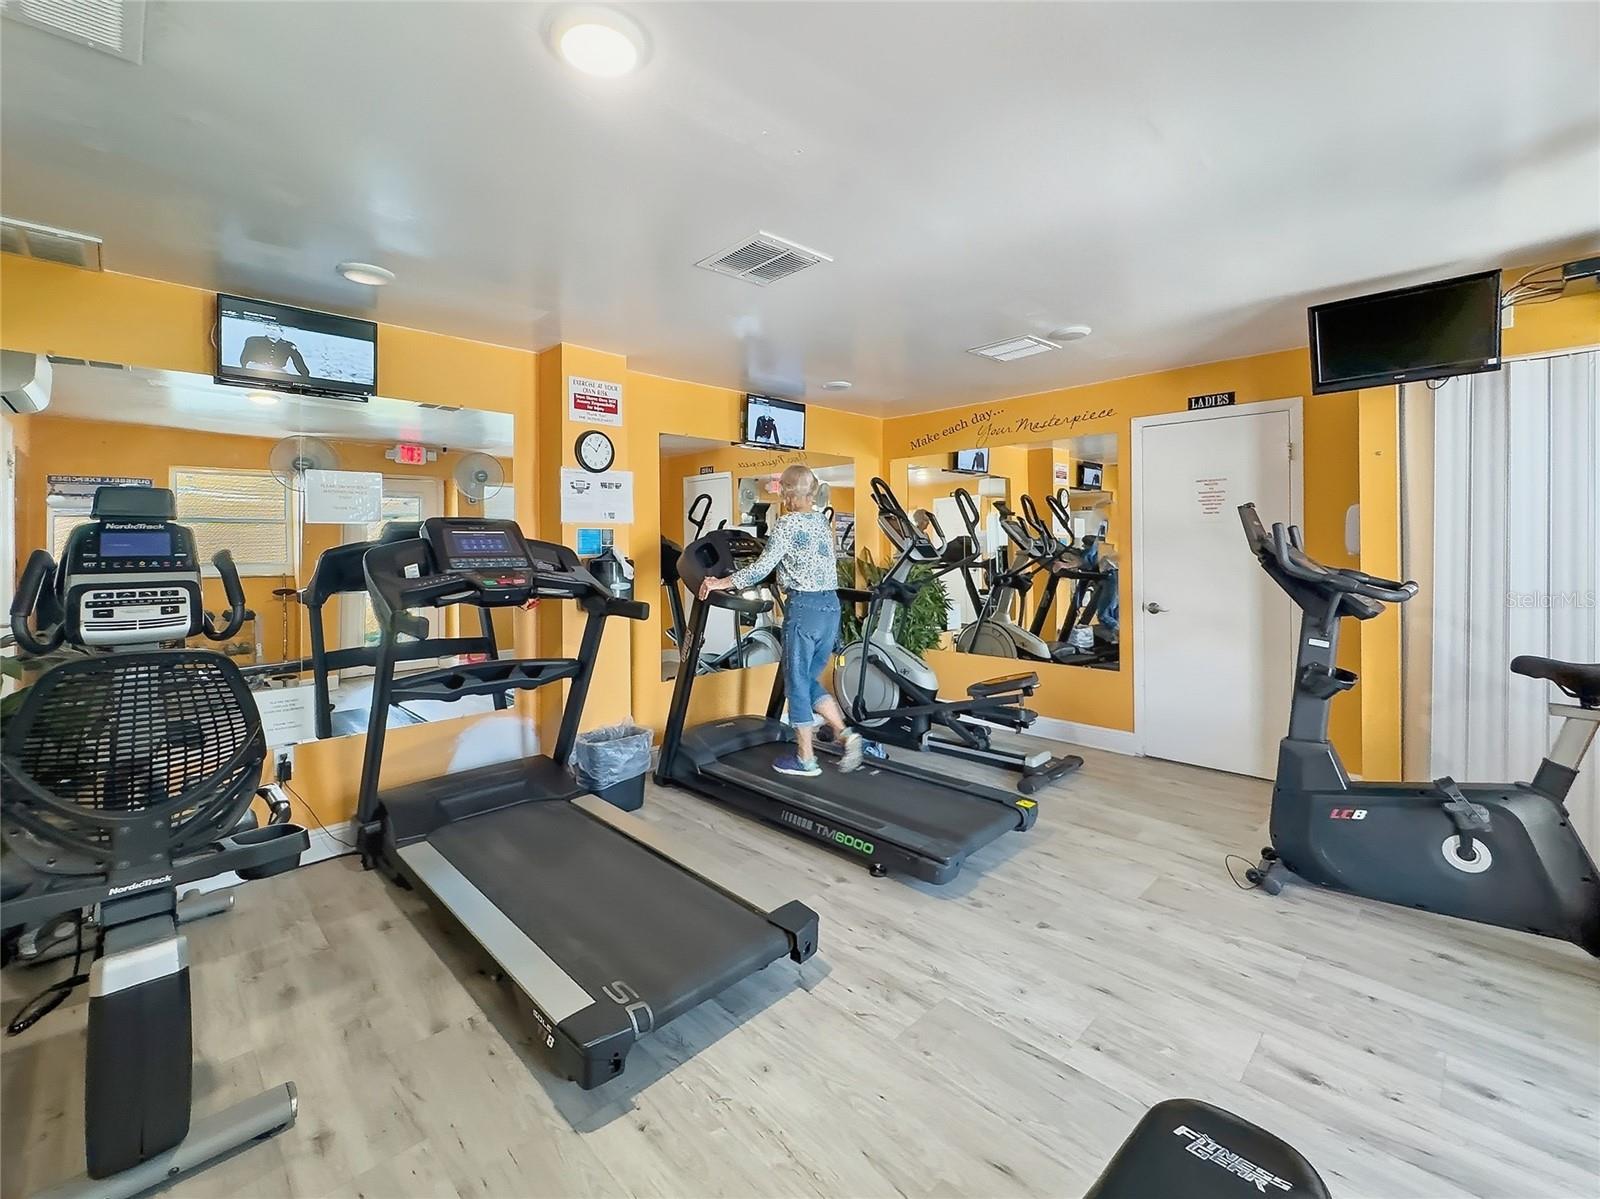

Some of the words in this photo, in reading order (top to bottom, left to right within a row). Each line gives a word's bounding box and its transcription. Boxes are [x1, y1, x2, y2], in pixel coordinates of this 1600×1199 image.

[1191, 394, 1229, 409] LADIES
[910, 433, 940, 450] Make
[942, 420, 969, 439] each
[975, 423, 1013, 449] Your
[1015, 408, 1118, 433] Masterpiece
[815, 823, 874, 854] TM6000
[108, 874, 172, 896] NordicTrack
[1173, 1125, 1293, 1191] FITNESS
[1185, 1141, 1269, 1193] GEAR
